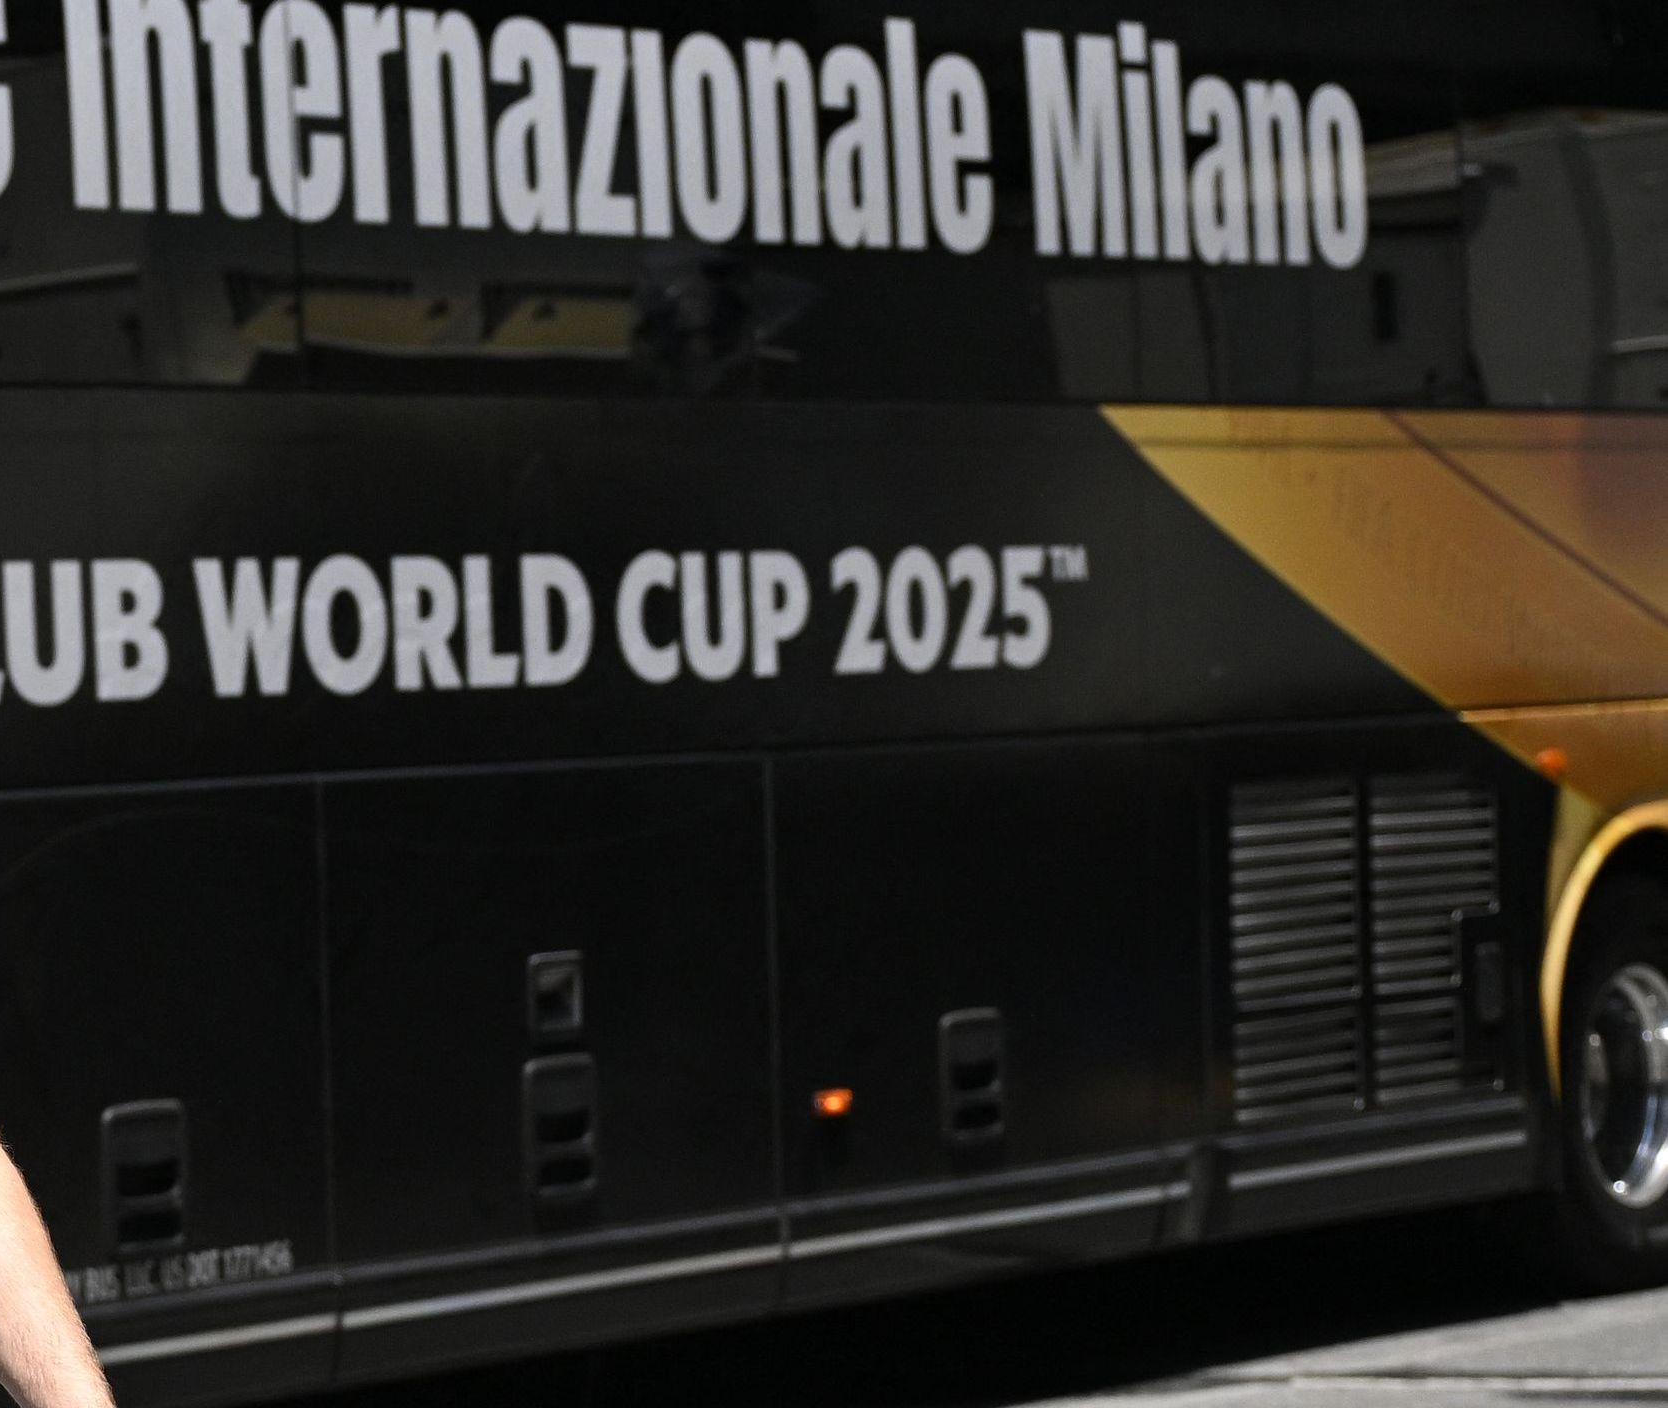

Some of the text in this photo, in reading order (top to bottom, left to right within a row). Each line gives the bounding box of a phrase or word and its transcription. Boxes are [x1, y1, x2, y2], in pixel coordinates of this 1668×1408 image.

[64, 0, 992, 252] Internazionale
[1025, 22, 1366, 267] Milano
[192, 552, 593, 697] WORLD
[617, 550, 810, 682] CUP
[85, 1264, 119, 1304] BUS
[186, 1248, 221, 1288] DOT
